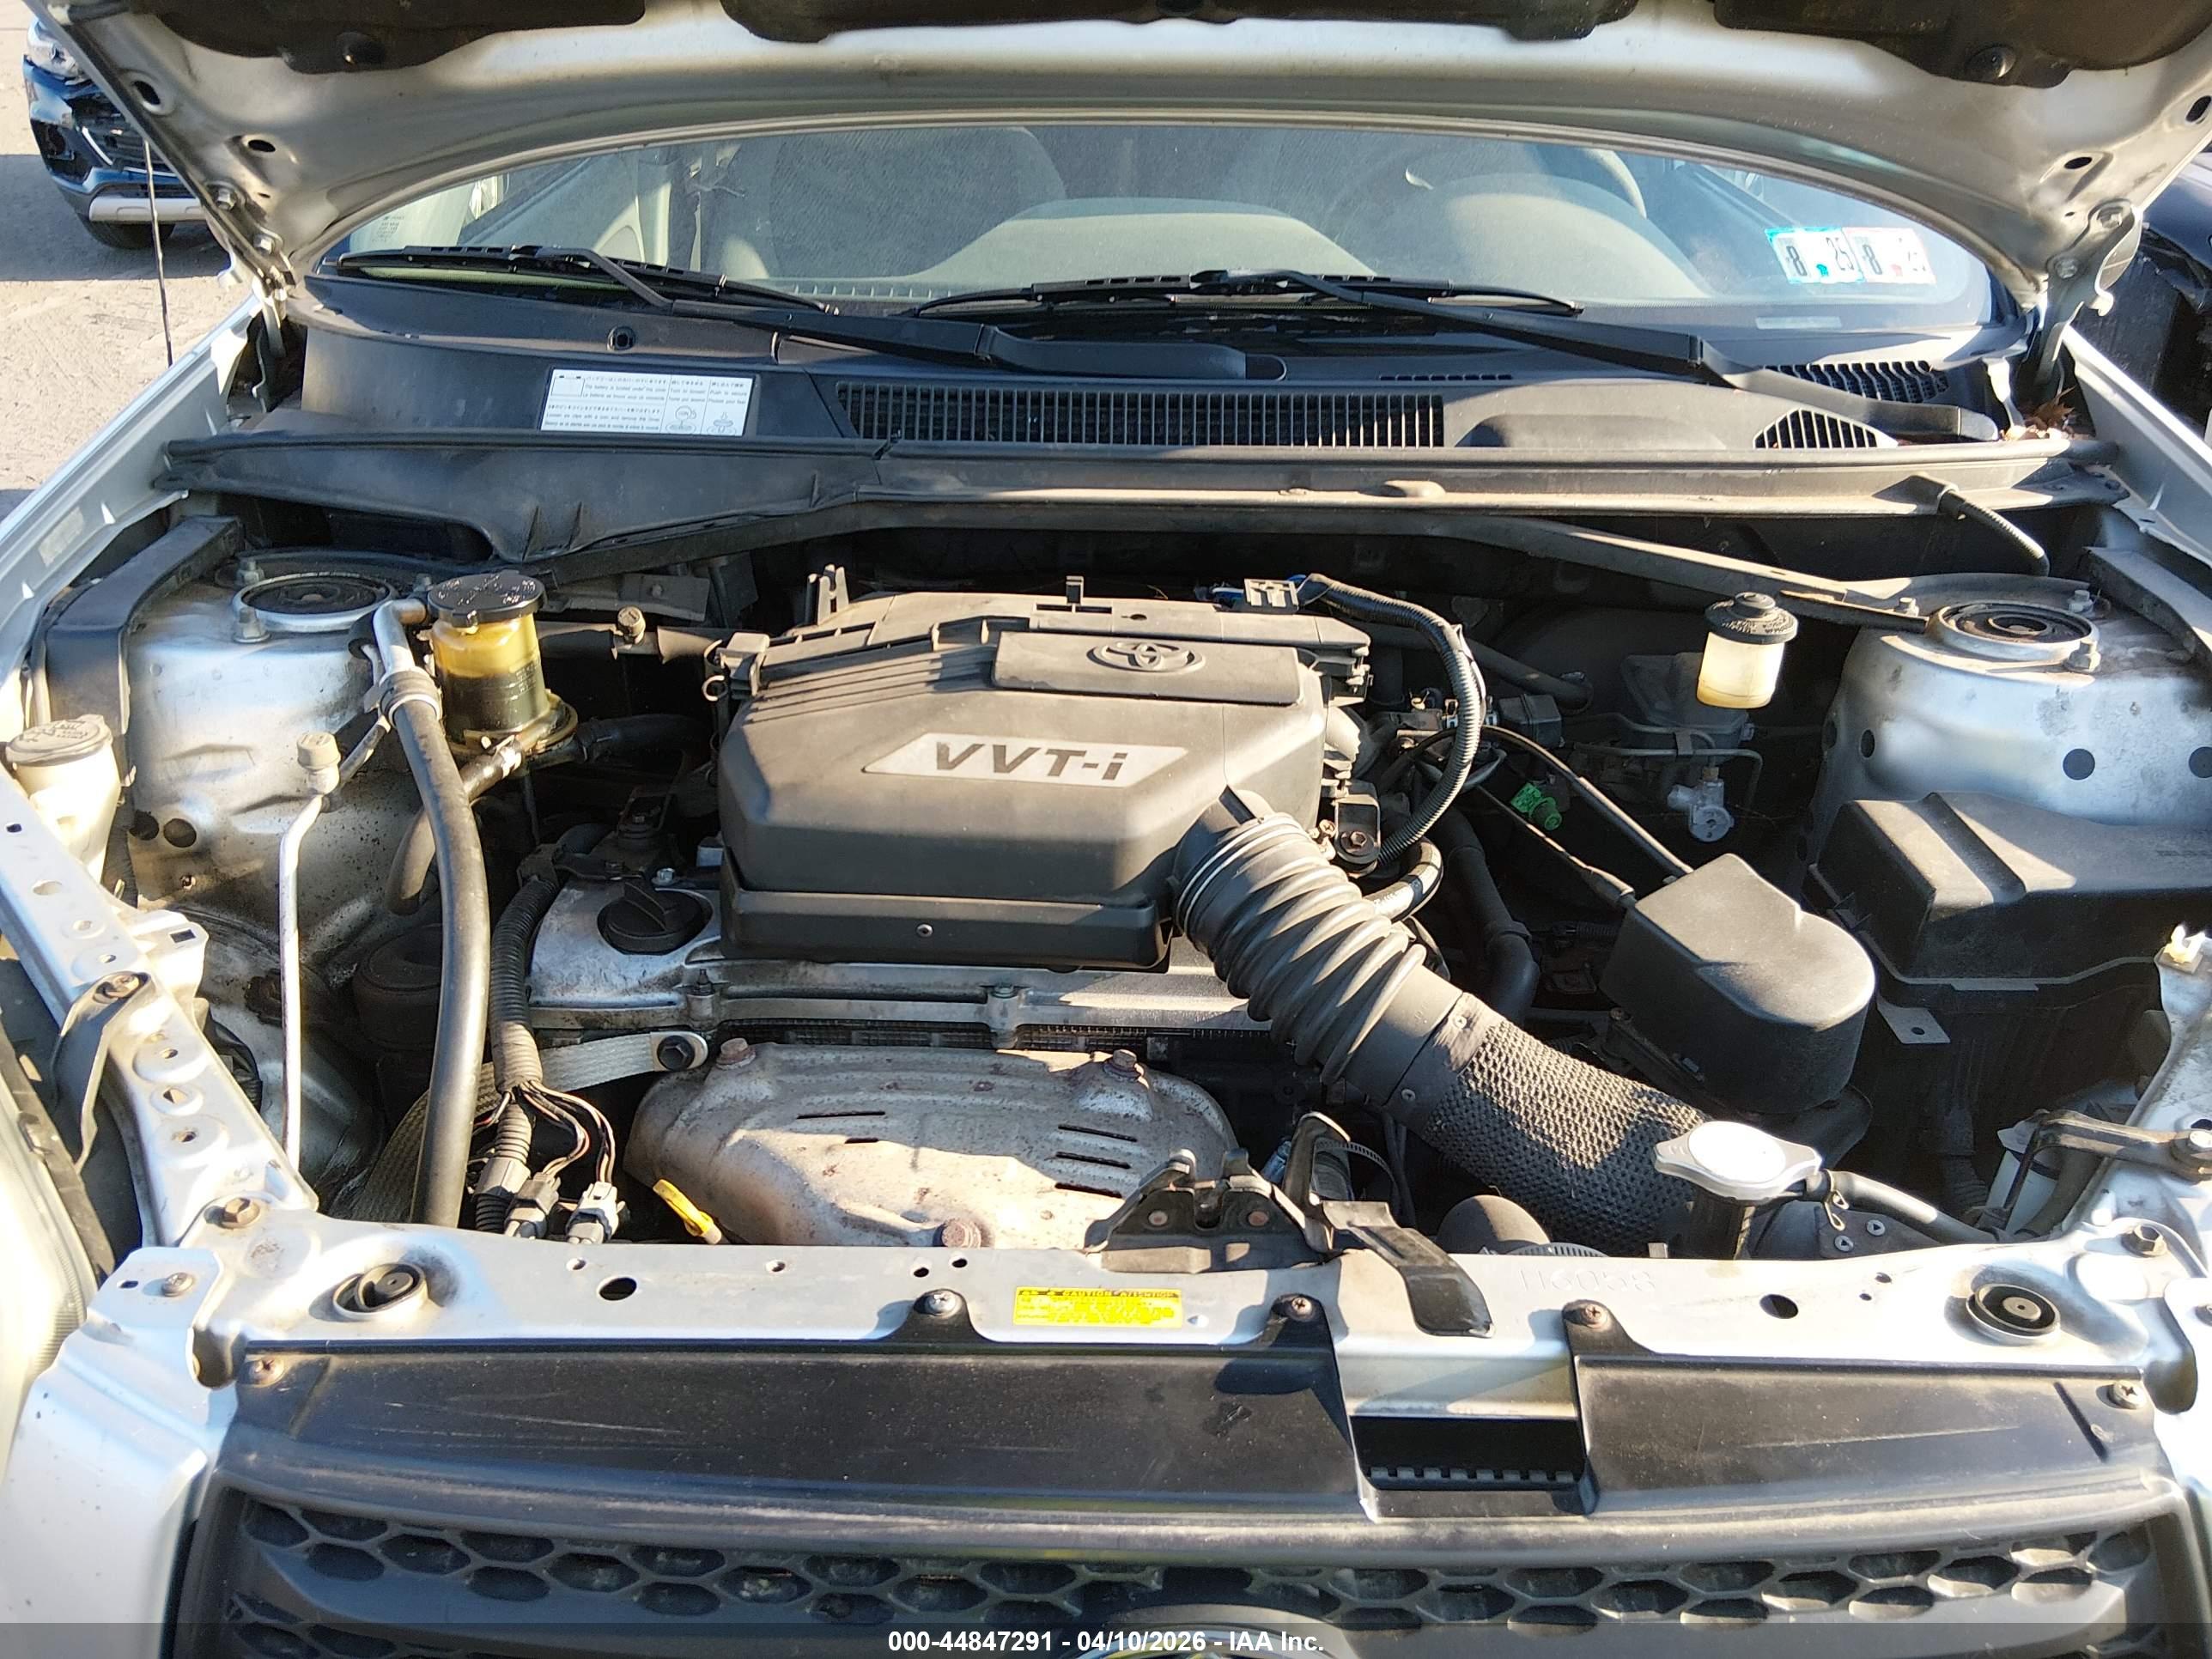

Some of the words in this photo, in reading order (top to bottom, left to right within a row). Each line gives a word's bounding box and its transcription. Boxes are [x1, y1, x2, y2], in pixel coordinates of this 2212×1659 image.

[1785, 245, 1808, 276] 8
[1863, 243, 1883, 276] 8
[936, 741, 1128, 781] VVT-i
